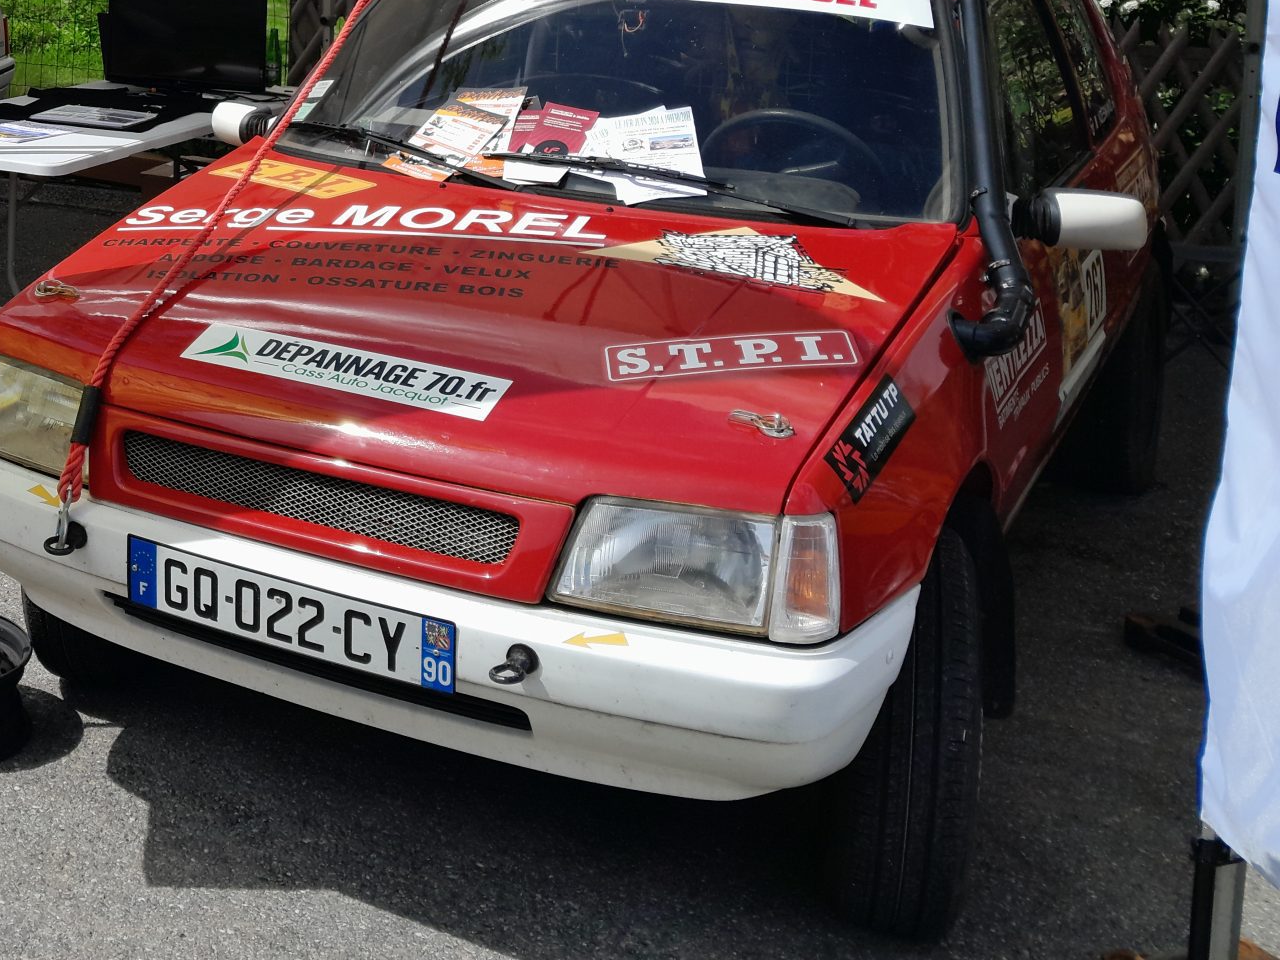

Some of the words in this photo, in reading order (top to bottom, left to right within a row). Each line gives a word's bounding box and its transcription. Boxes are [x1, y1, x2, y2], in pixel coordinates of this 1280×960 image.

[332, 205, 607, 240] MOREL
[269, 239, 443, 257] COUVERTURE
[470, 249, 620, 269] ZINGUERIE
[291, 257, 414, 272] BARDAGE
[444, 265, 532, 280] VELUX
[307, 276, 448, 293] OSSATURE
[458, 285, 526, 298] BOIS
[255, 338, 426, 387] DÉPANNAGE
[424, 371, 497, 402] 70.fr
[282, 363, 368, 389] Cass'Auto
[368, 381, 449, 407] Jacquot
[854, 398, 889, 448] TATTU
[883, 383, 899, 408] TP
[139, 581, 148, 596] F
[164, 557, 406, 672] GQ-022-CY
[423, 656, 452, 687] 90
